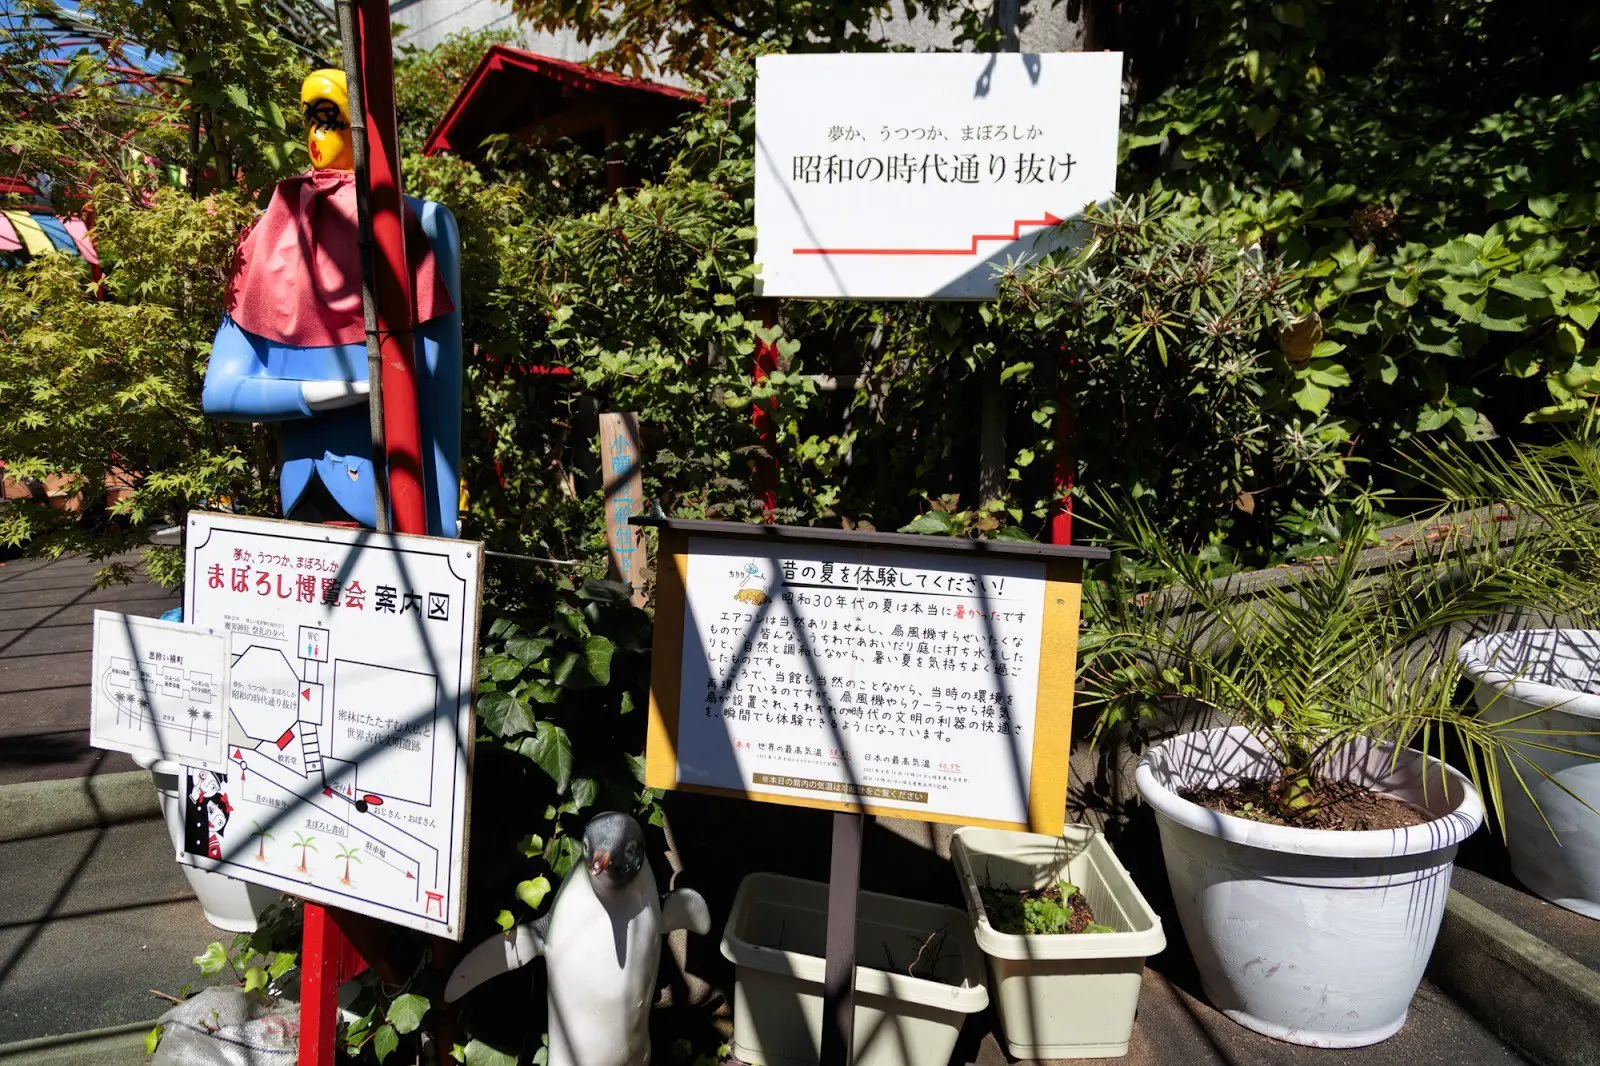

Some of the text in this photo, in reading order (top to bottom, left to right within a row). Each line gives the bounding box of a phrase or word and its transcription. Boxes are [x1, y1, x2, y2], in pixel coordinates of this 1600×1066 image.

[827, 124, 1043, 142] 夢か、うつつか、まぼろしか
[792, 152, 1077, 185] 昭和の時代通り抜け
[232, 548, 339, 574] 夢か、うつつか、まぼろしか
[207, 563, 450, 621] まぼろし博覧会 案内図
[307, 631, 320, 642] WC
[231, 689, 298, 710] 昭和の時代通り抜け
[347, 726, 422, 753] 世界古代文明遺跡
[758, 742, 822, 757] 世界の最高気温
[864, 753, 931, 768] 日本の最高気温
[305, 818, 345, 836] まぼろし書店
[365, 840, 387, 859] 駐車場
